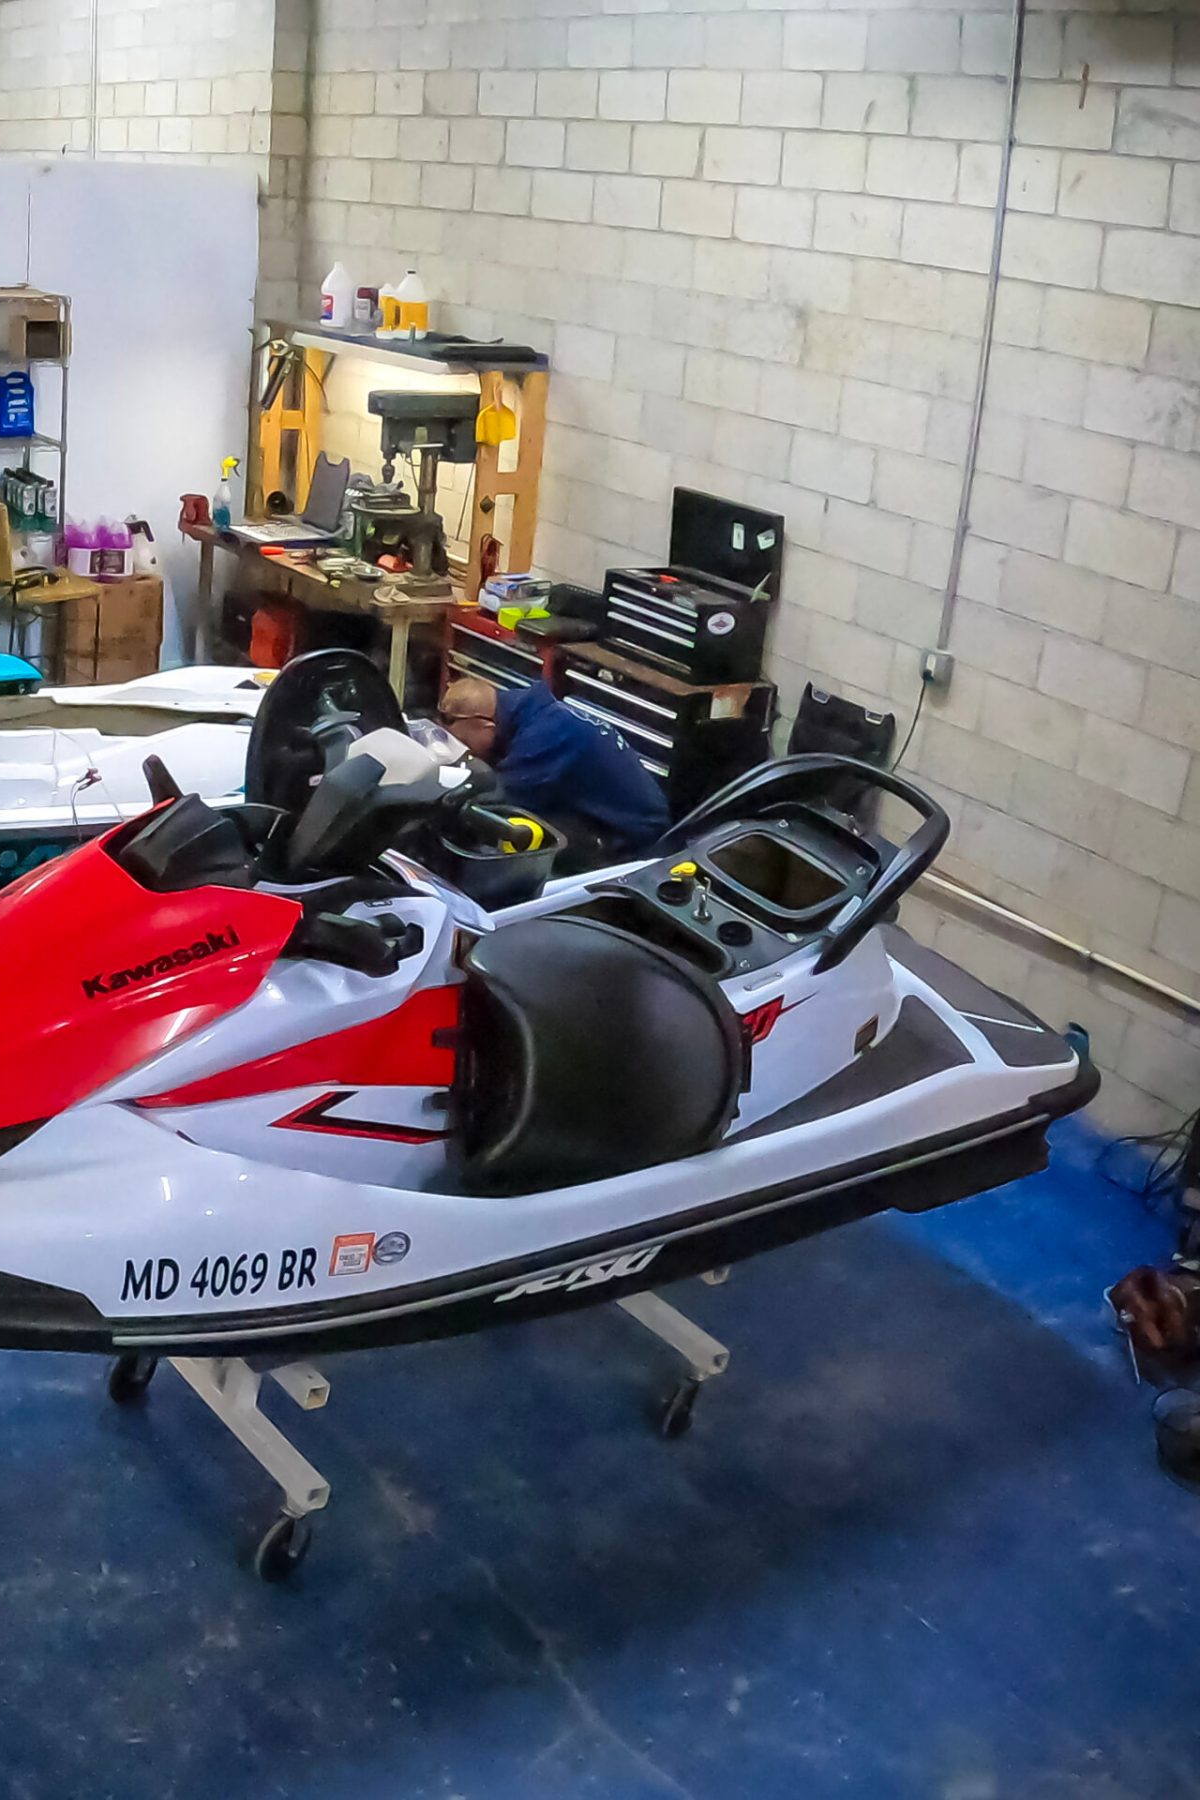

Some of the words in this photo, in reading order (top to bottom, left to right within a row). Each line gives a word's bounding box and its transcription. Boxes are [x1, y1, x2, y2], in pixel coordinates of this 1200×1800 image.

[81, 925, 240, 998] Kawasaki
[121, 1259, 180, 1300] MD
[190, 1253, 268, 1298] 4069
[278, 1247, 318, 1290] BR
